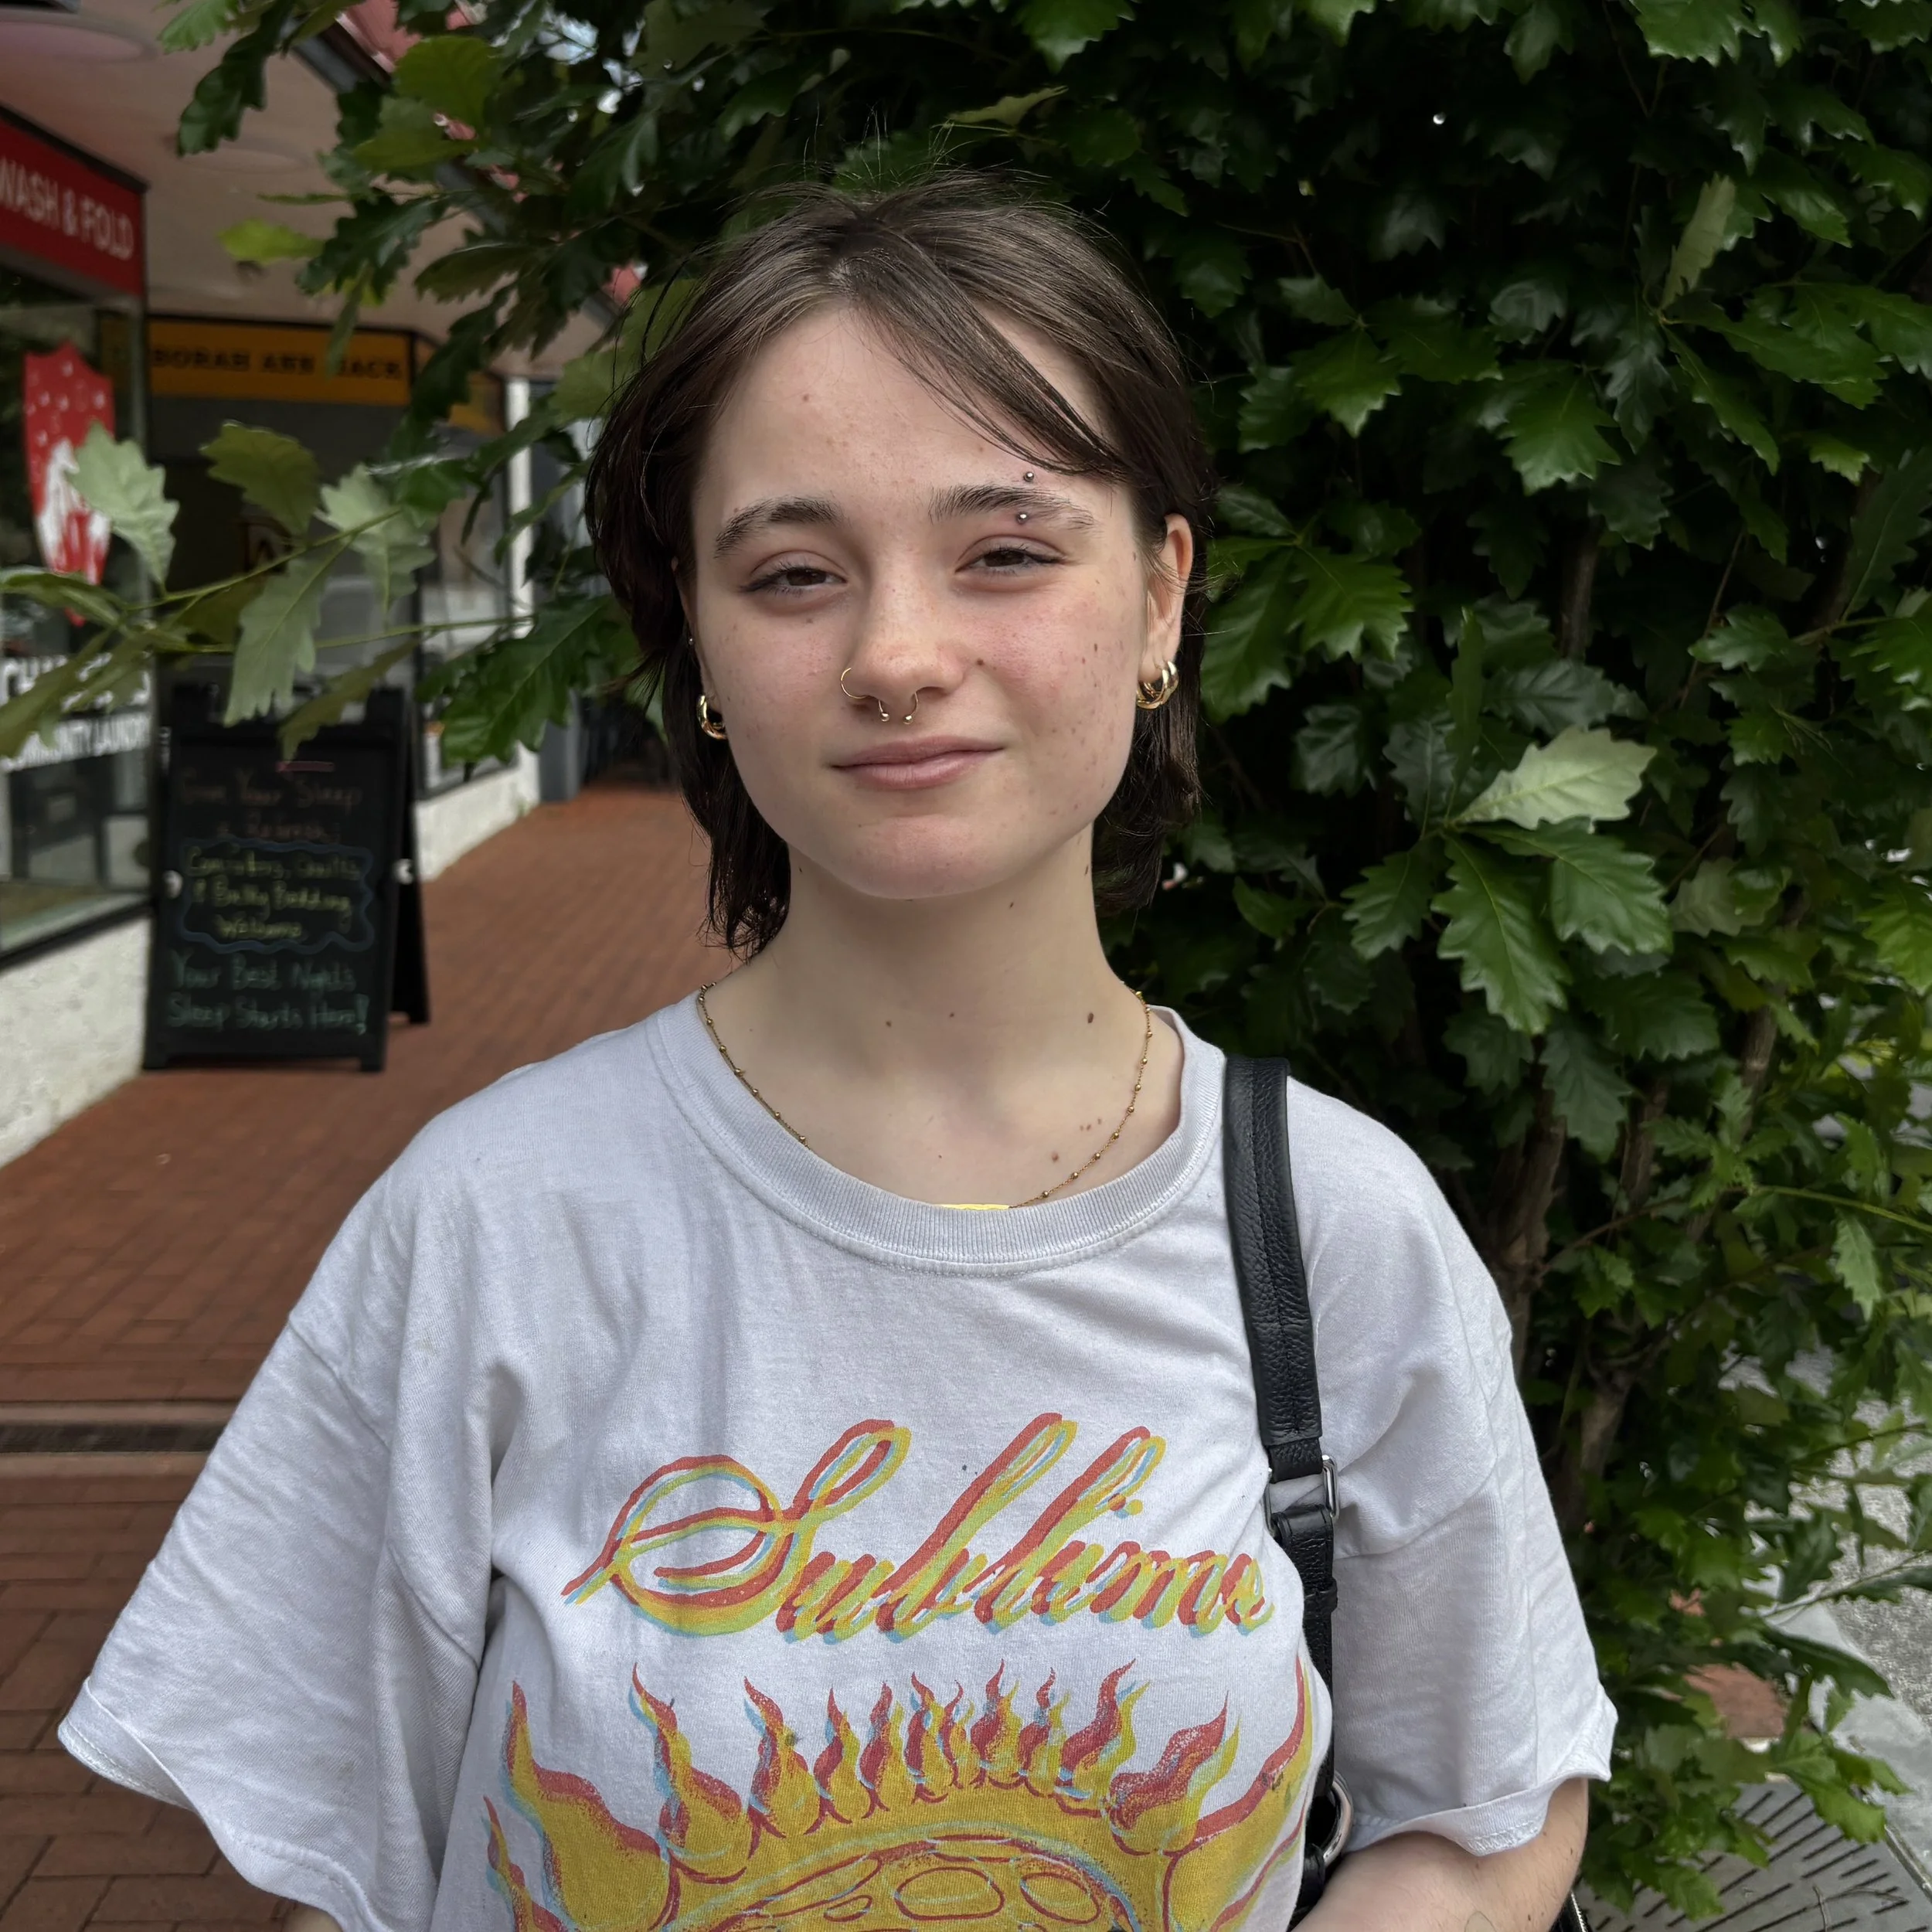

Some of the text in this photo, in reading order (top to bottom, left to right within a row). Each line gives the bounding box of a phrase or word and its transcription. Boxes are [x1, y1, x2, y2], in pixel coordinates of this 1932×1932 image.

[80, 194, 134, 260] FOLD
[169, 948, 222, 990] Your
[230, 953, 283, 990] Best
[562, 1413, 1271, 1642] Sublime
